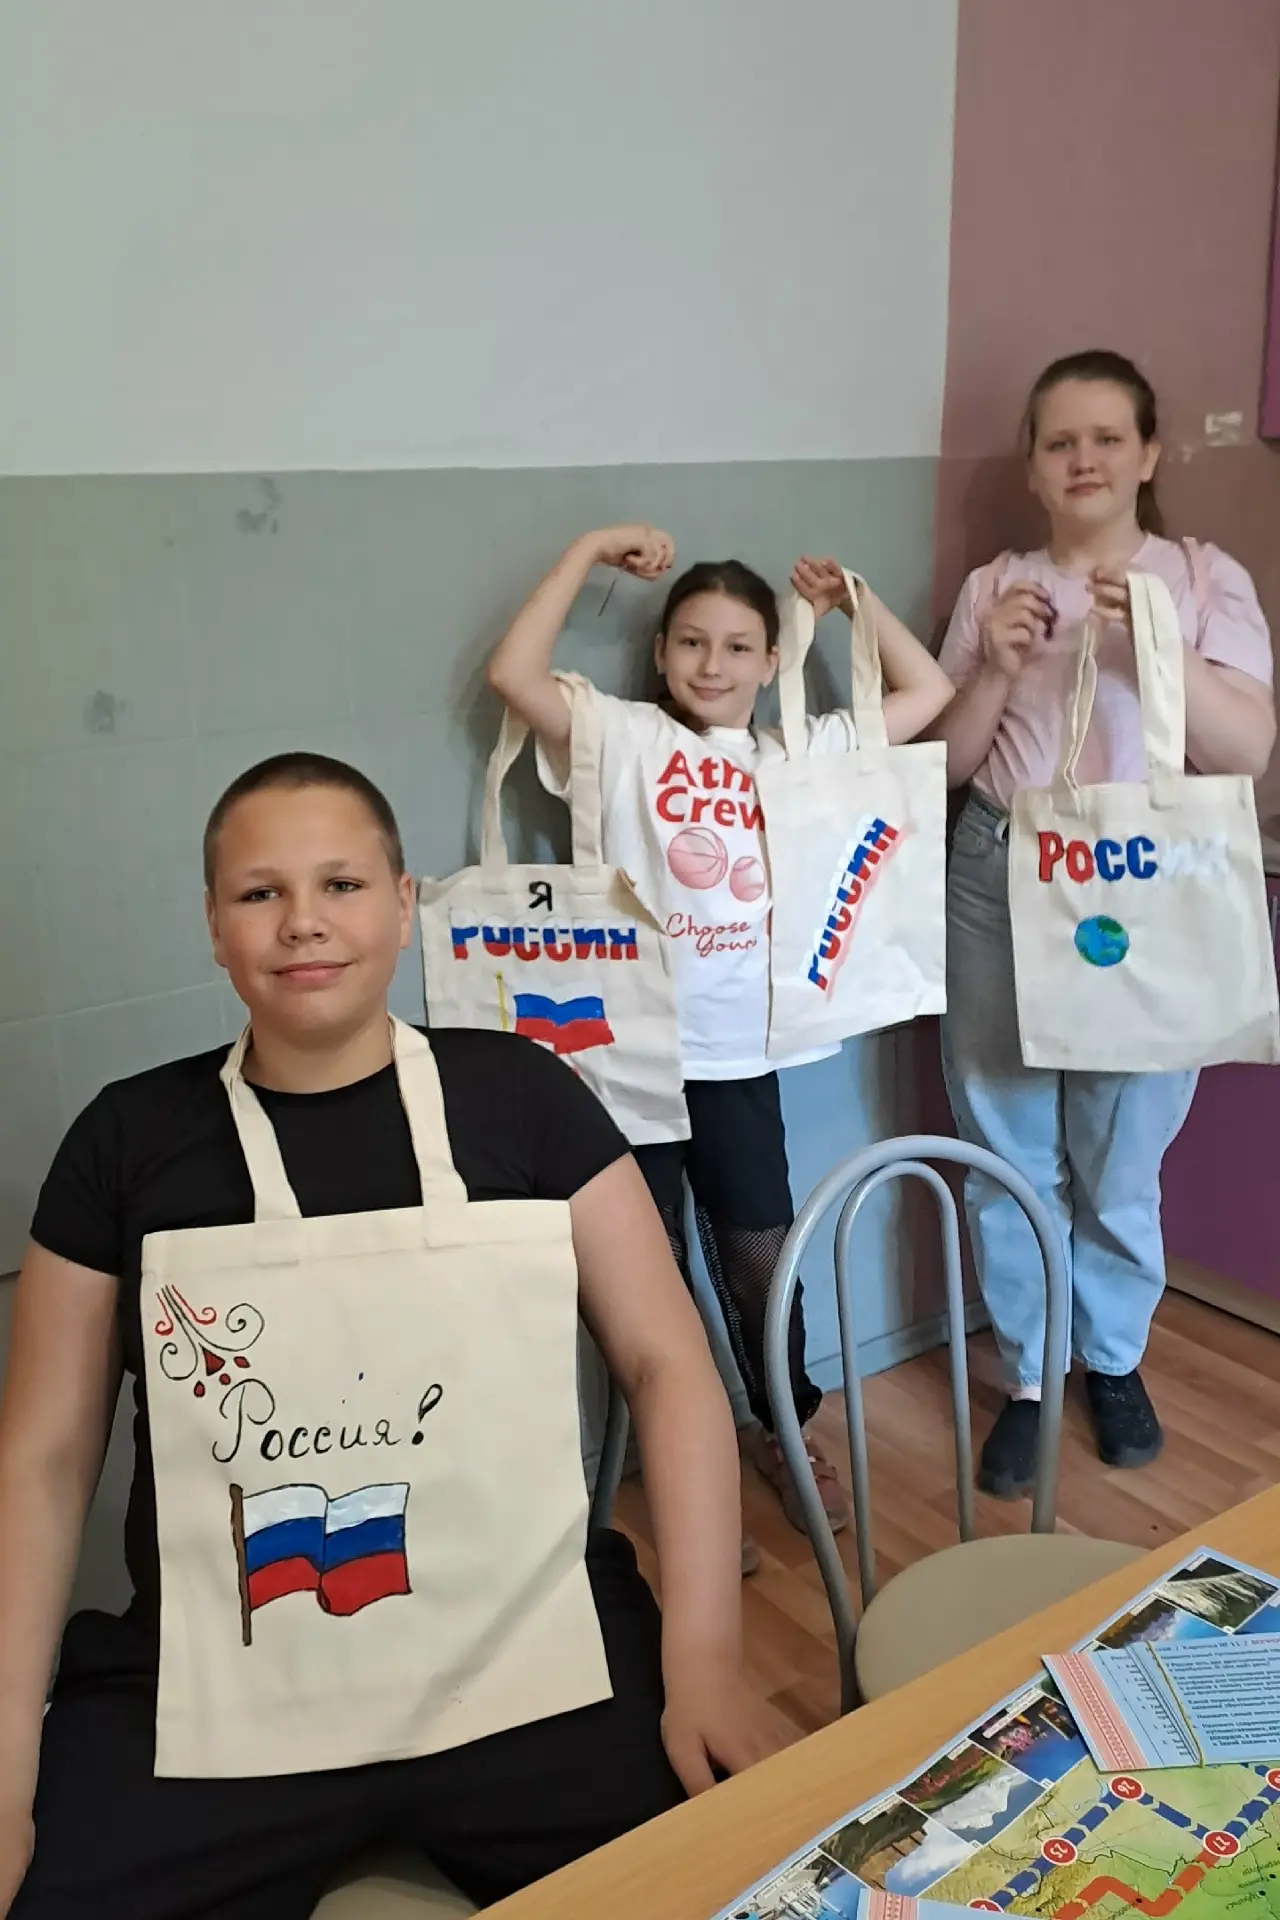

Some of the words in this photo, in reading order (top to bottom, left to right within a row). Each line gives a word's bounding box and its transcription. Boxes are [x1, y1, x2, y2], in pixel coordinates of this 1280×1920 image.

[527, 880, 553, 912] Я
[666, 912, 752, 938] Choose
[1118, 1779, 1137, 1795] 26
[1049, 1843, 1069, 1861] 25
